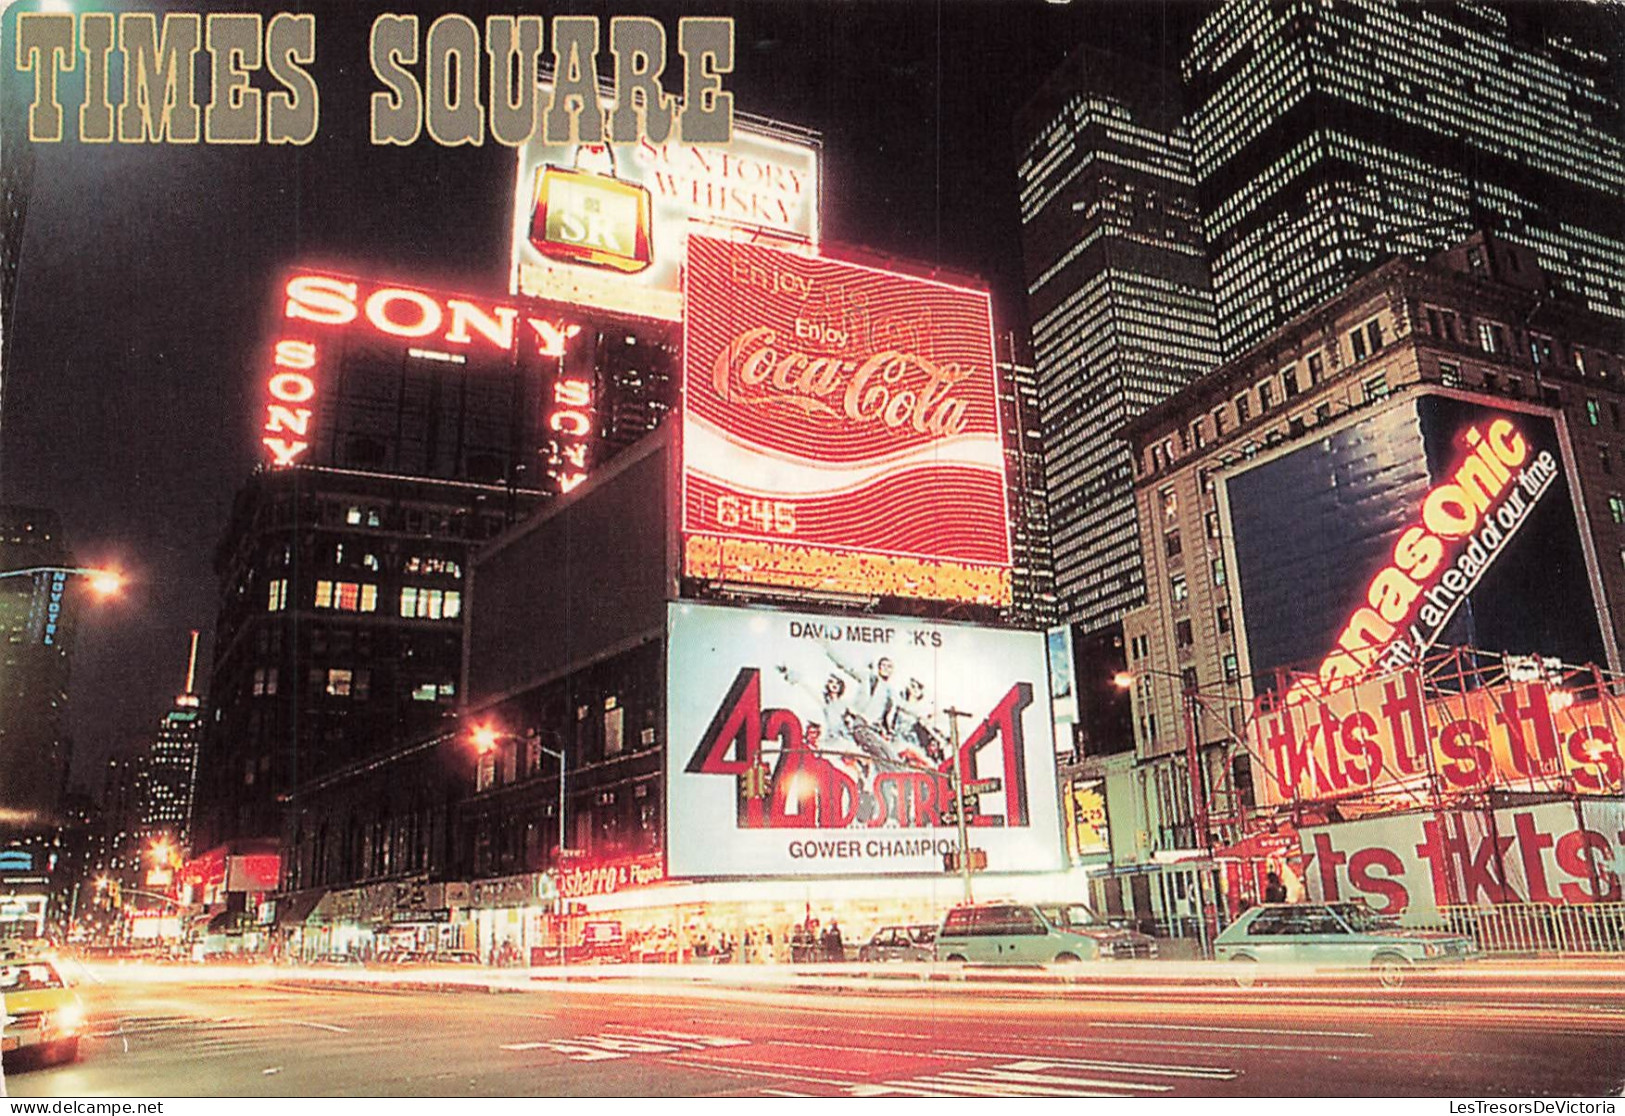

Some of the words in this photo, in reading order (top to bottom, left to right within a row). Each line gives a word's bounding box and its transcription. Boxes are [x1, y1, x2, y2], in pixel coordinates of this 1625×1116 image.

[655, 170, 796, 224] WHISKY
[285, 276, 581, 357] SONY
[795, 316, 849, 348] Enjoy
[263, 340, 316, 467] SONY
[712, 326, 976, 436] Coca-Cola
[1420, 535, 1487, 628] ahead
[1480, 513, 1502, 551] of
[1496, 487, 1526, 529] our
[1518, 450, 1556, 496] time
[789, 621, 842, 641] DAVID
[1267, 702, 1384, 799] tkts
[789, 839, 862, 859] GOWER
